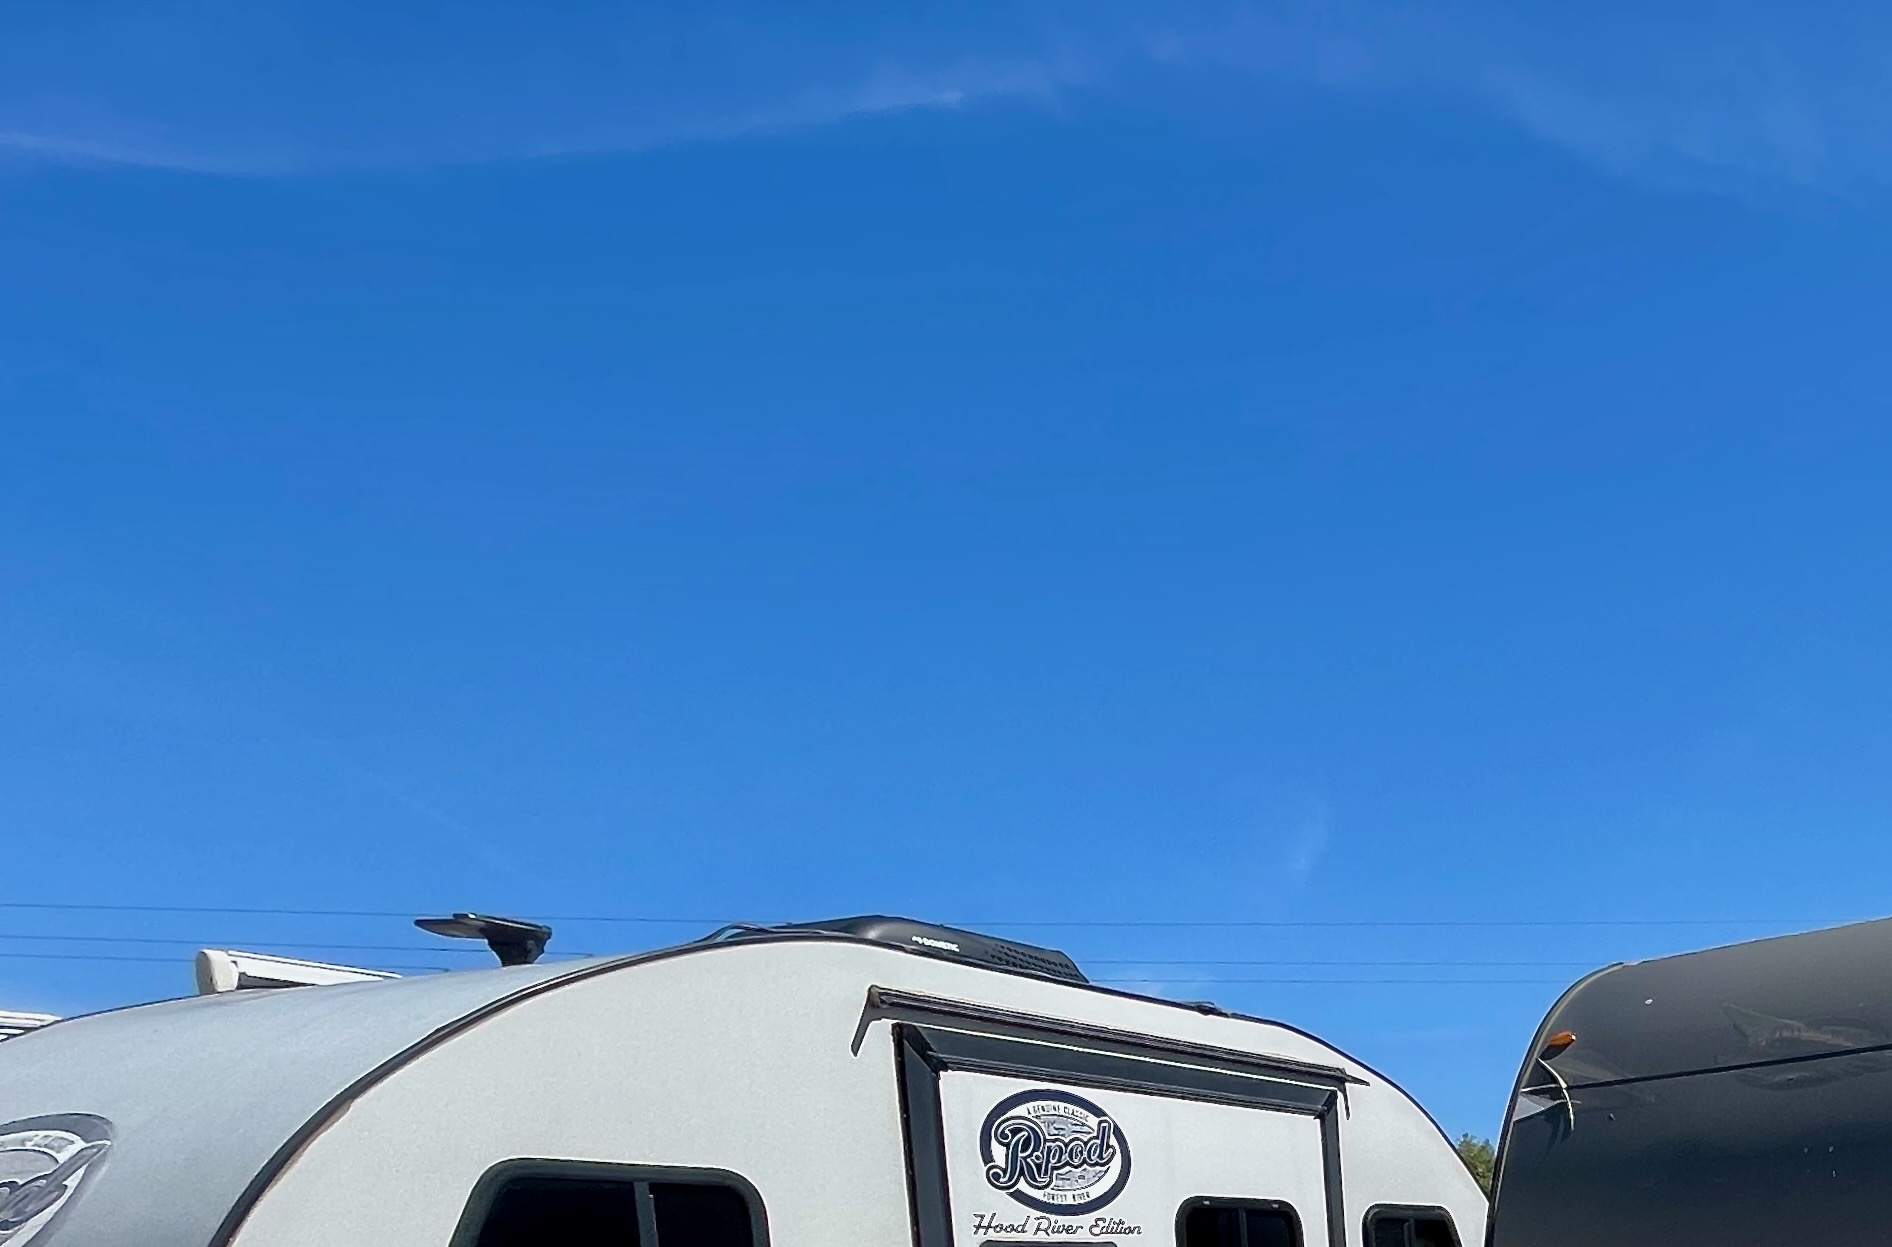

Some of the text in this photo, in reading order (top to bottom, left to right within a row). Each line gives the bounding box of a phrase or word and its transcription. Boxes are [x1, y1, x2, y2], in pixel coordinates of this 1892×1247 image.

[972, 1212, 1142, 1237] Hood River Edition
